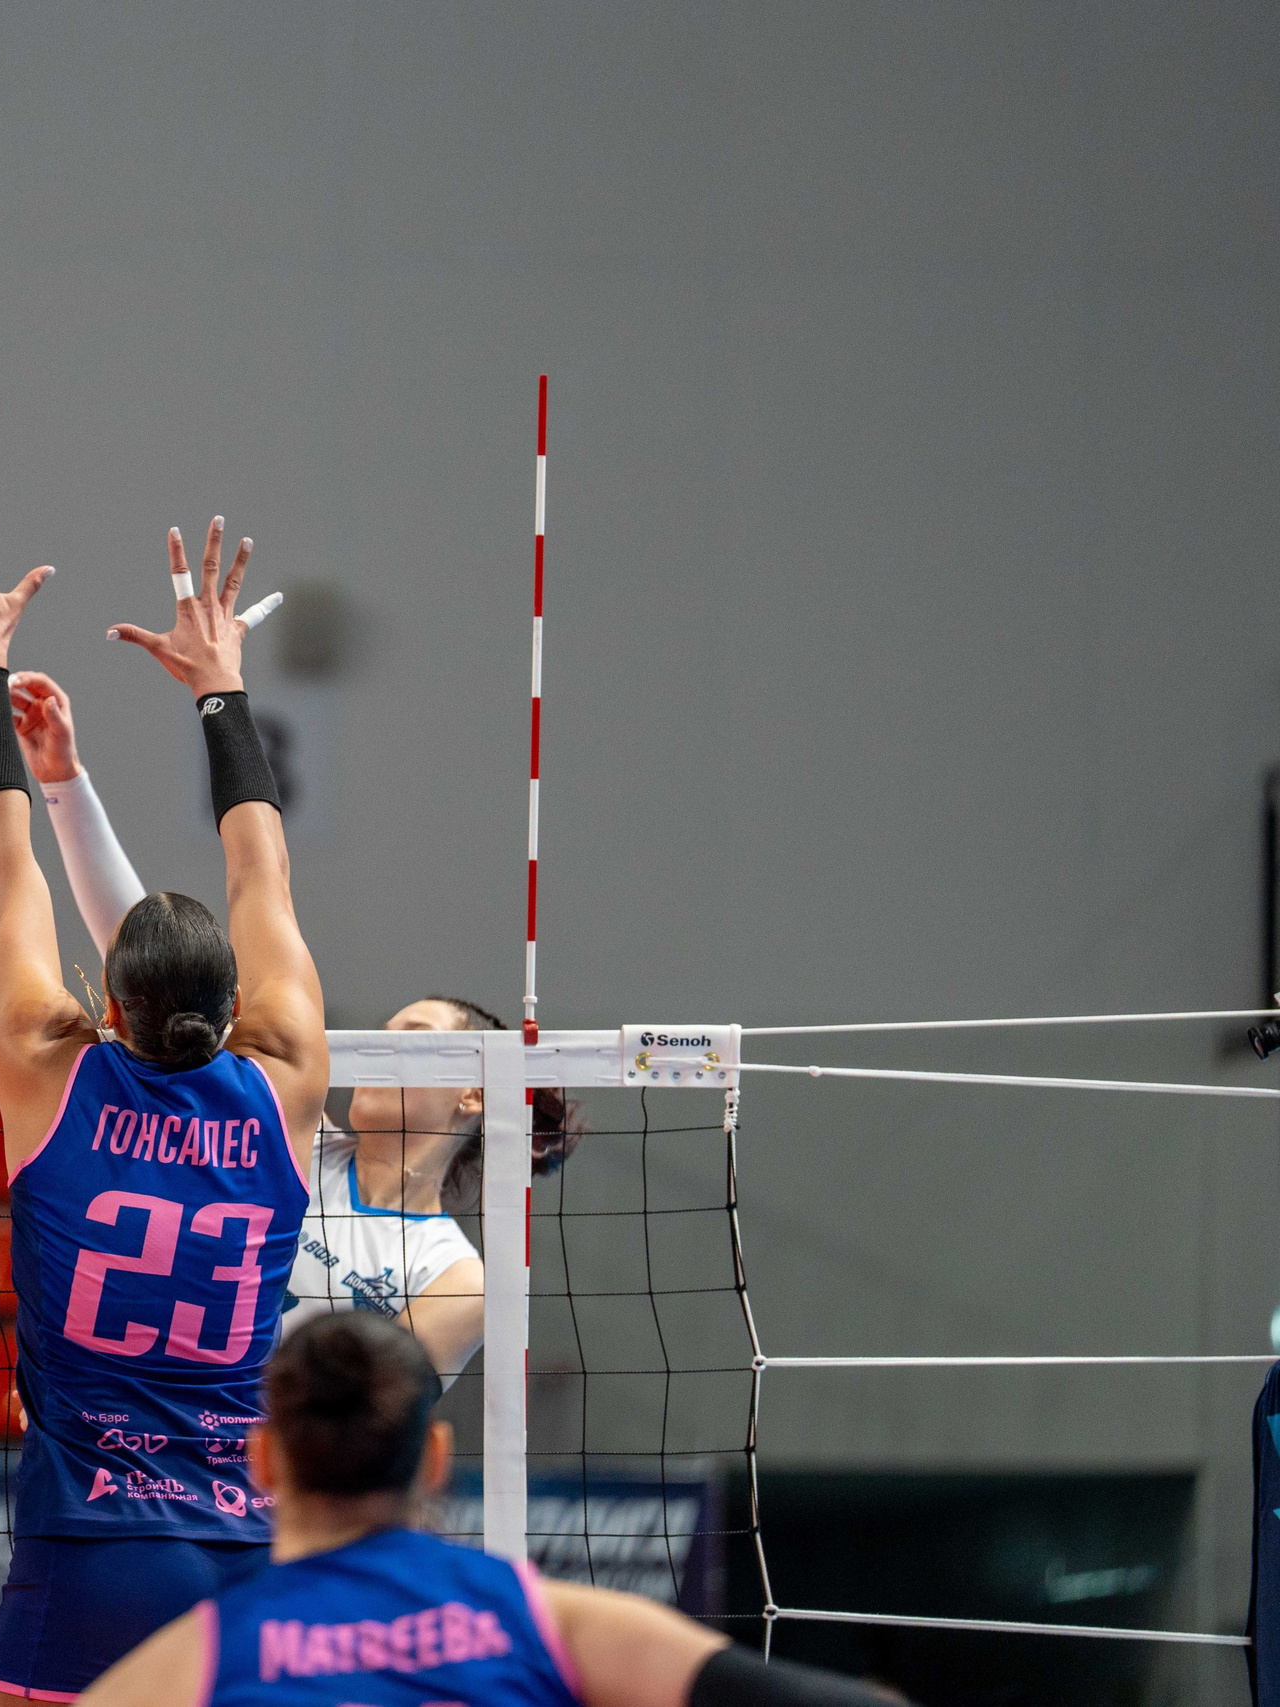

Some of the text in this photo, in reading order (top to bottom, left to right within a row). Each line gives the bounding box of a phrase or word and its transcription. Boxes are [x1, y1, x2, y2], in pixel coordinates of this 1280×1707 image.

[657, 1034, 711, 1047] Senoh
[91, 1103, 261, 1169] ГОНСАЛЕС
[63, 1190, 275, 1365] 23
[99, 1414, 130, 1424] Барс
[126, 1470, 184, 1492] ГРНЬ
